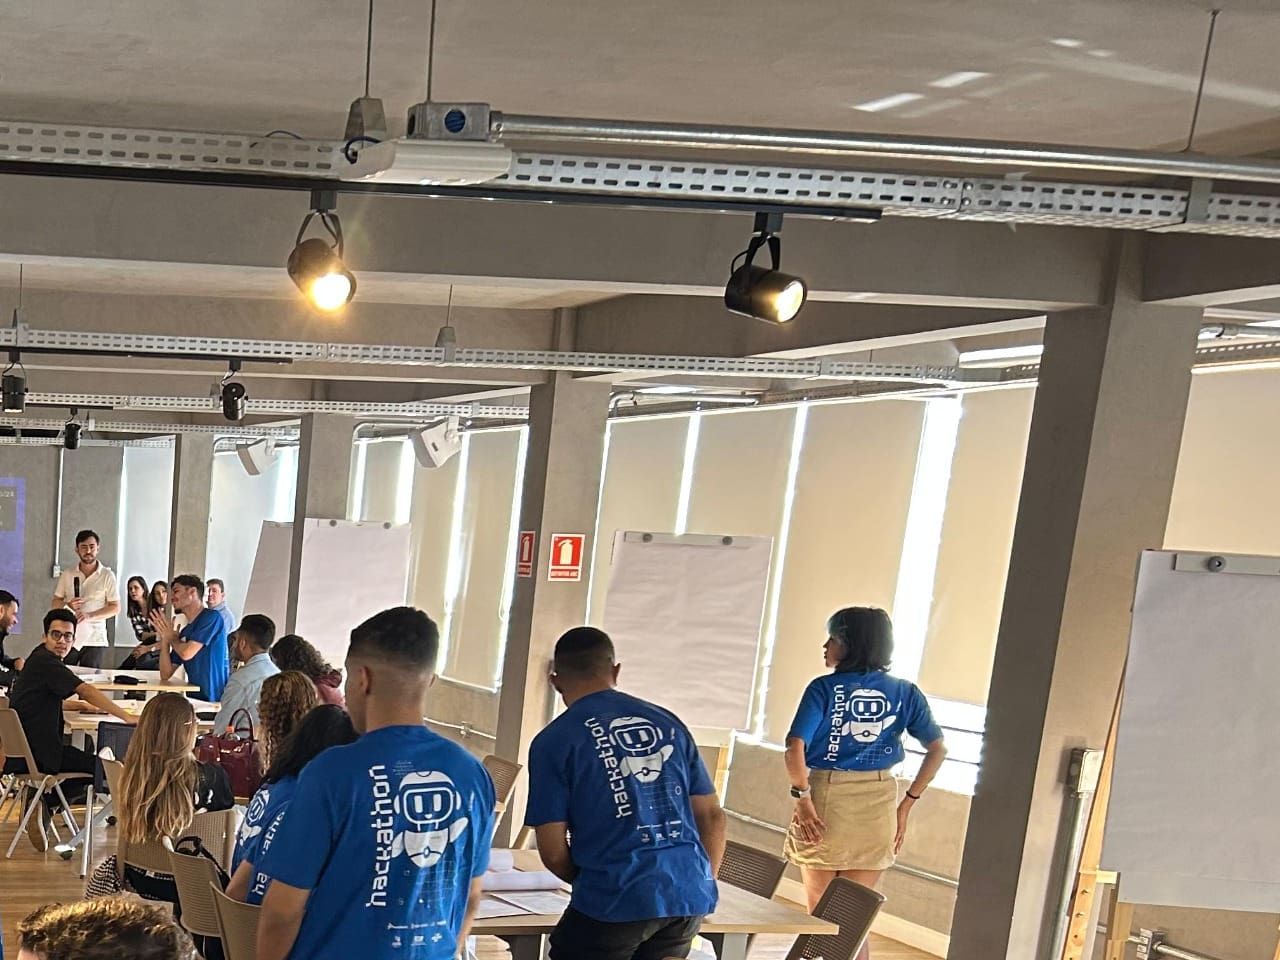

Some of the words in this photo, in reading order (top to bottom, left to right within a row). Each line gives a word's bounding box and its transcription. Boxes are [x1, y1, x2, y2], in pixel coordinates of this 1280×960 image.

[584, 717, 633, 819] hackathon
[823, 684, 845, 762] hackathon
[365, 764, 395, 908] hackathon
